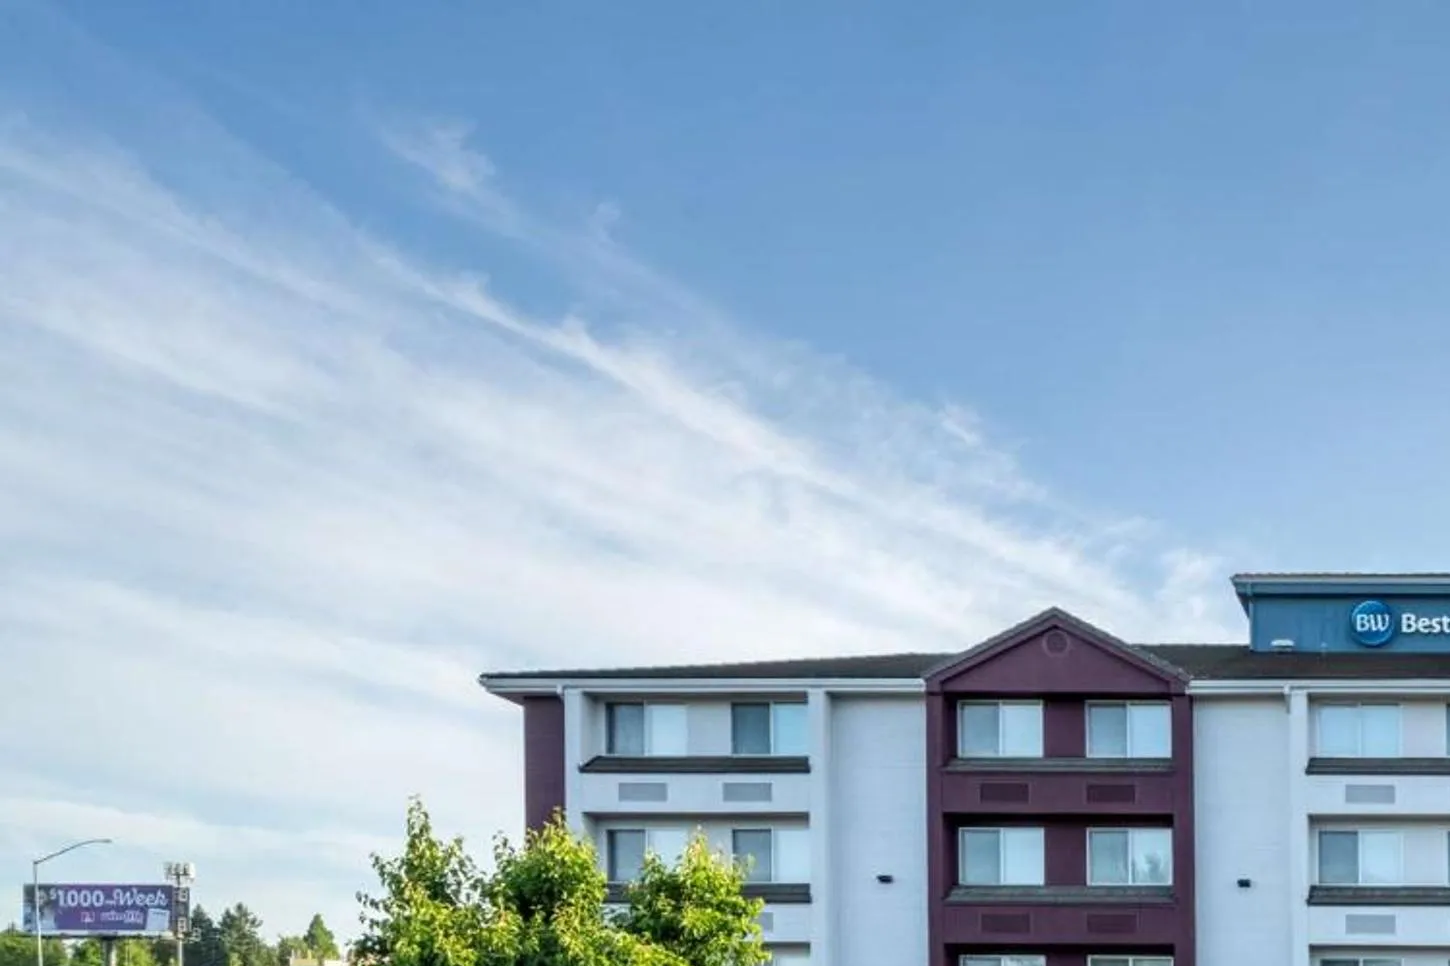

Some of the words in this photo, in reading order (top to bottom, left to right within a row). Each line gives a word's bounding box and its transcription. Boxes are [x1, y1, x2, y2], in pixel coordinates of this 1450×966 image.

[1356, 614, 1390, 632] BW
[1401, 613, 1450, 633] Best
[113, 888, 168, 906] Week
